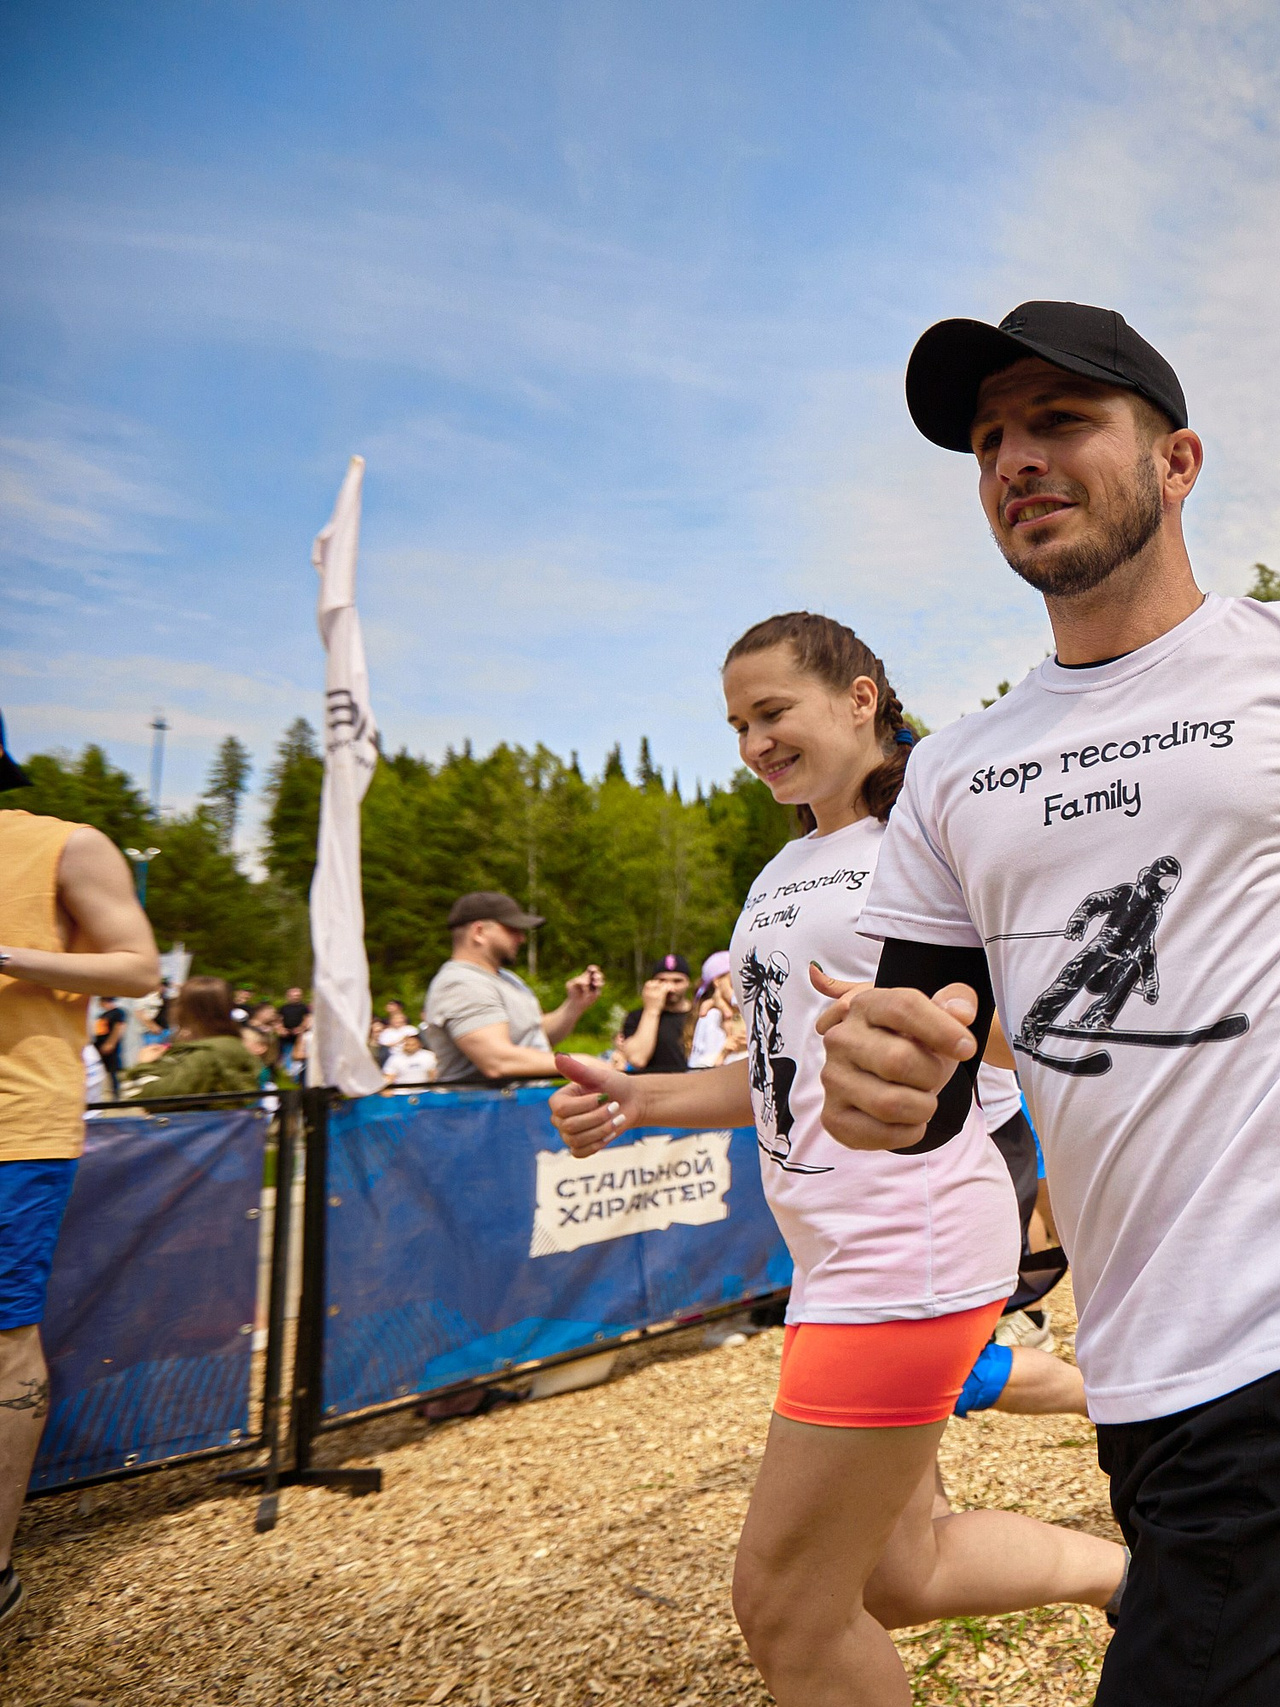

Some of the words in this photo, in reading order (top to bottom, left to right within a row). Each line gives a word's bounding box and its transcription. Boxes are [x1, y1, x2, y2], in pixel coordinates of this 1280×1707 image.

[969, 761, 1042, 794] Stop
[1060, 720, 1235, 773] recording
[1043, 779, 1142, 826] Family
[773, 868, 870, 899] recording
[749, 903, 801, 932] Family
[556, 1150, 715, 1198] СТАЛЬНОЙ
[558, 1180, 717, 1228] ХАРАКТЕР
